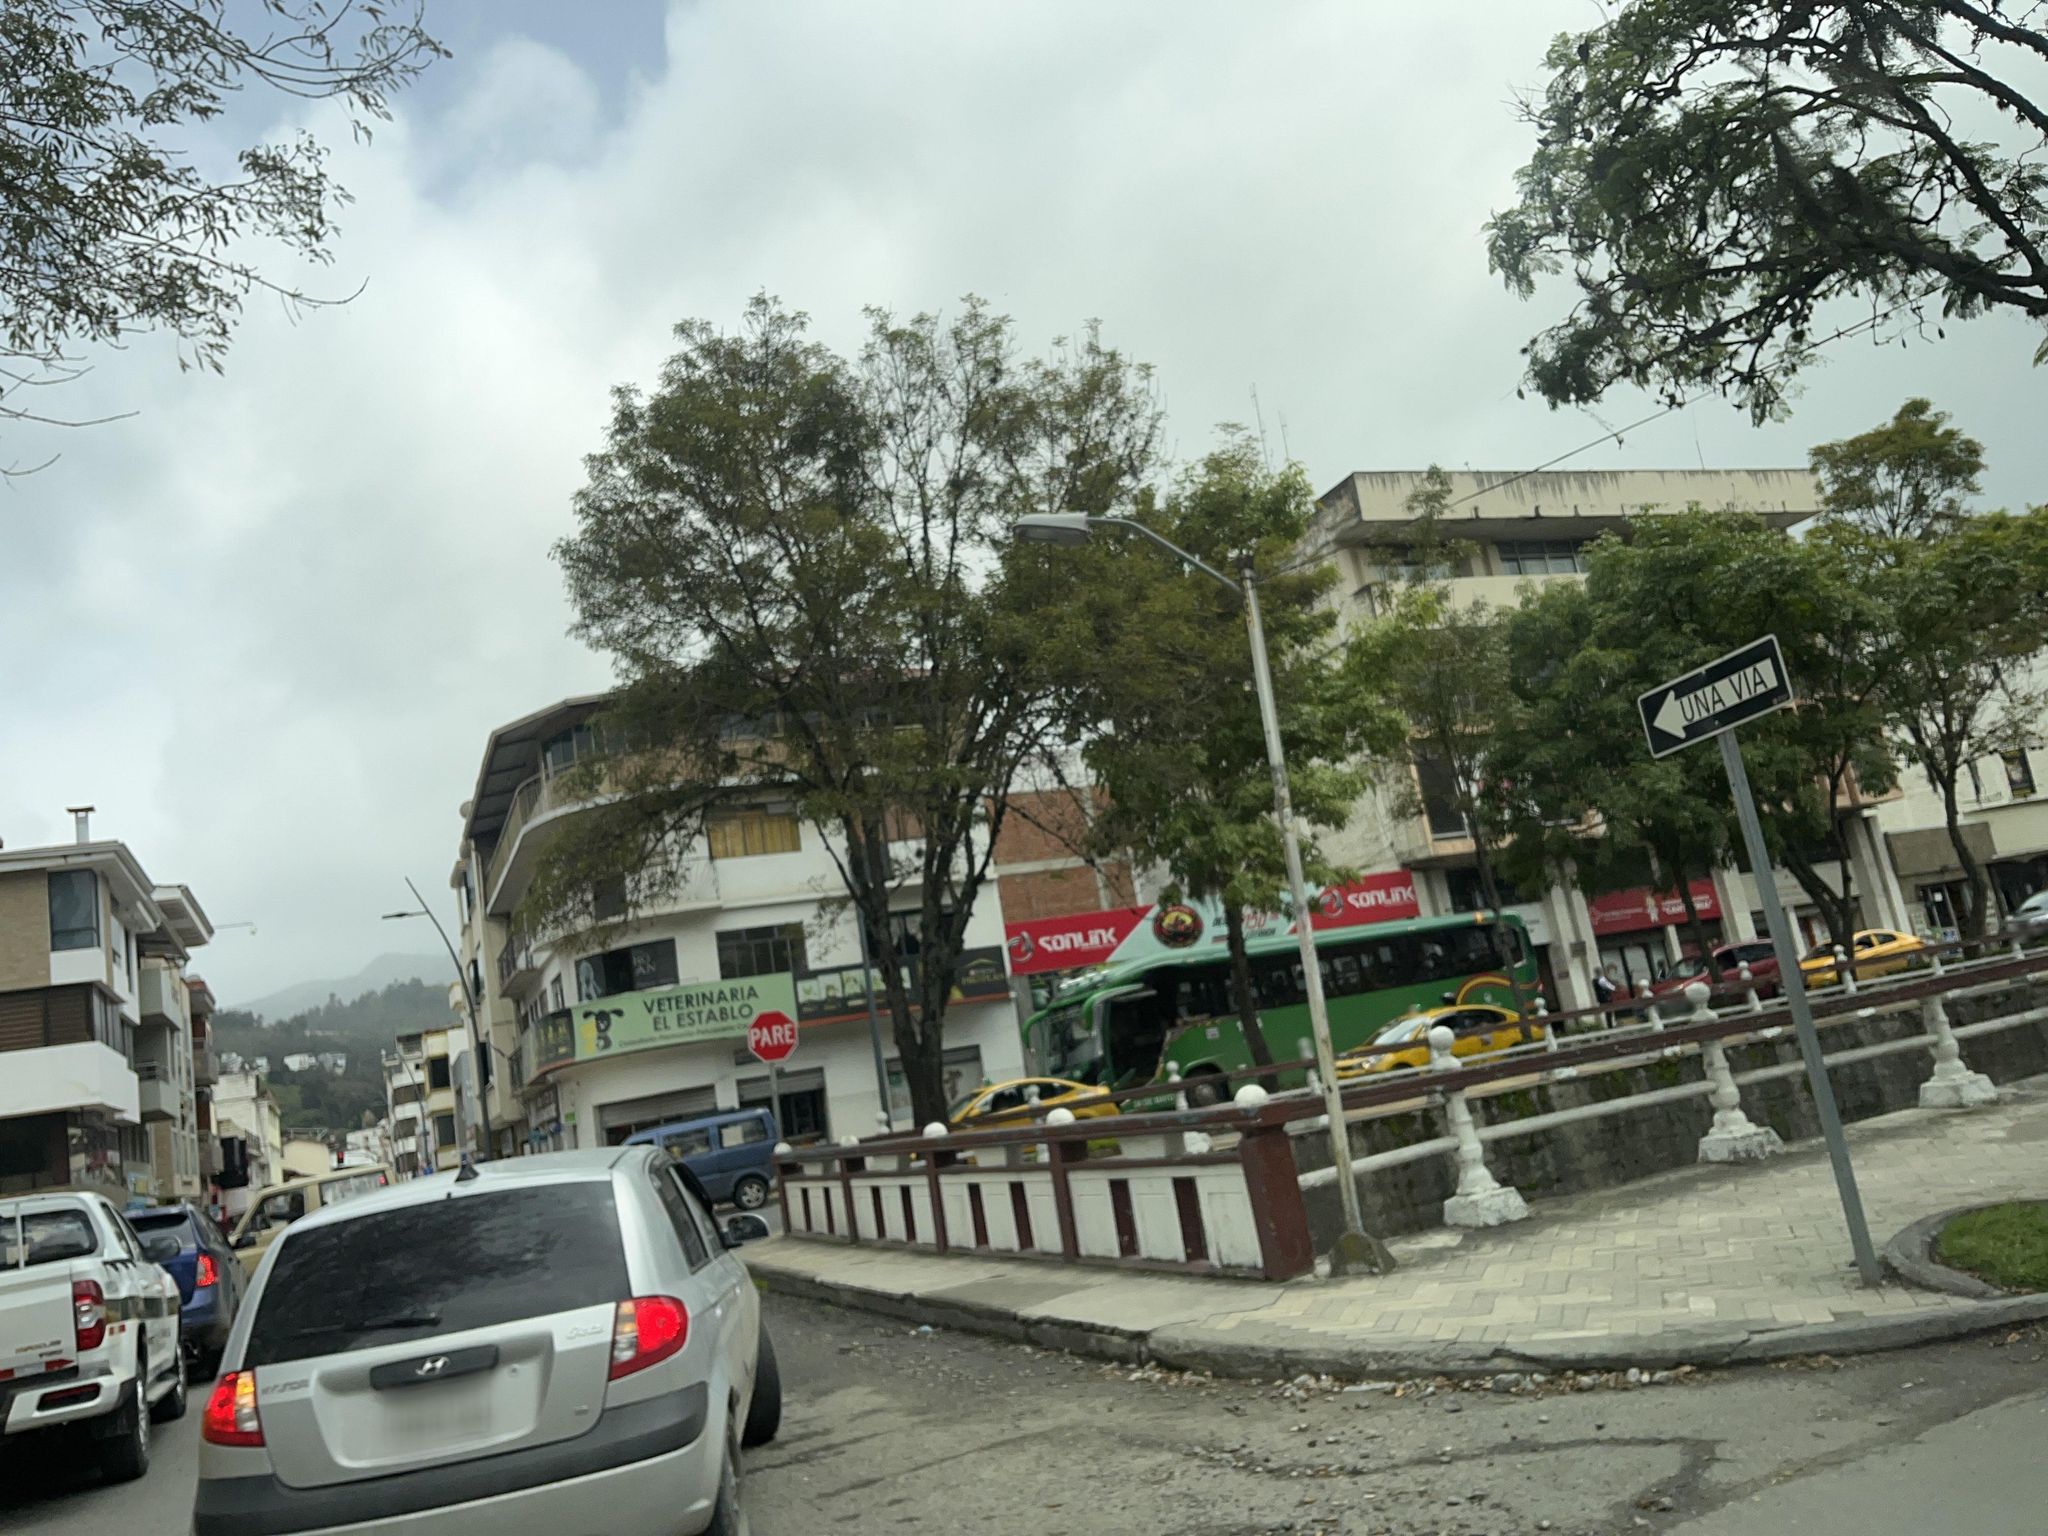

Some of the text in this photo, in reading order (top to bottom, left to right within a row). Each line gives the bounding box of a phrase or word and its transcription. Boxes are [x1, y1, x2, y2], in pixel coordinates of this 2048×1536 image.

[1679, 667, 1768, 722] UNA VIA
[643, 986, 759, 1014] VETERINARIA
[653, 1004, 753, 1032] EL ESTABLO
[750, 1025, 796, 1049] PARE
